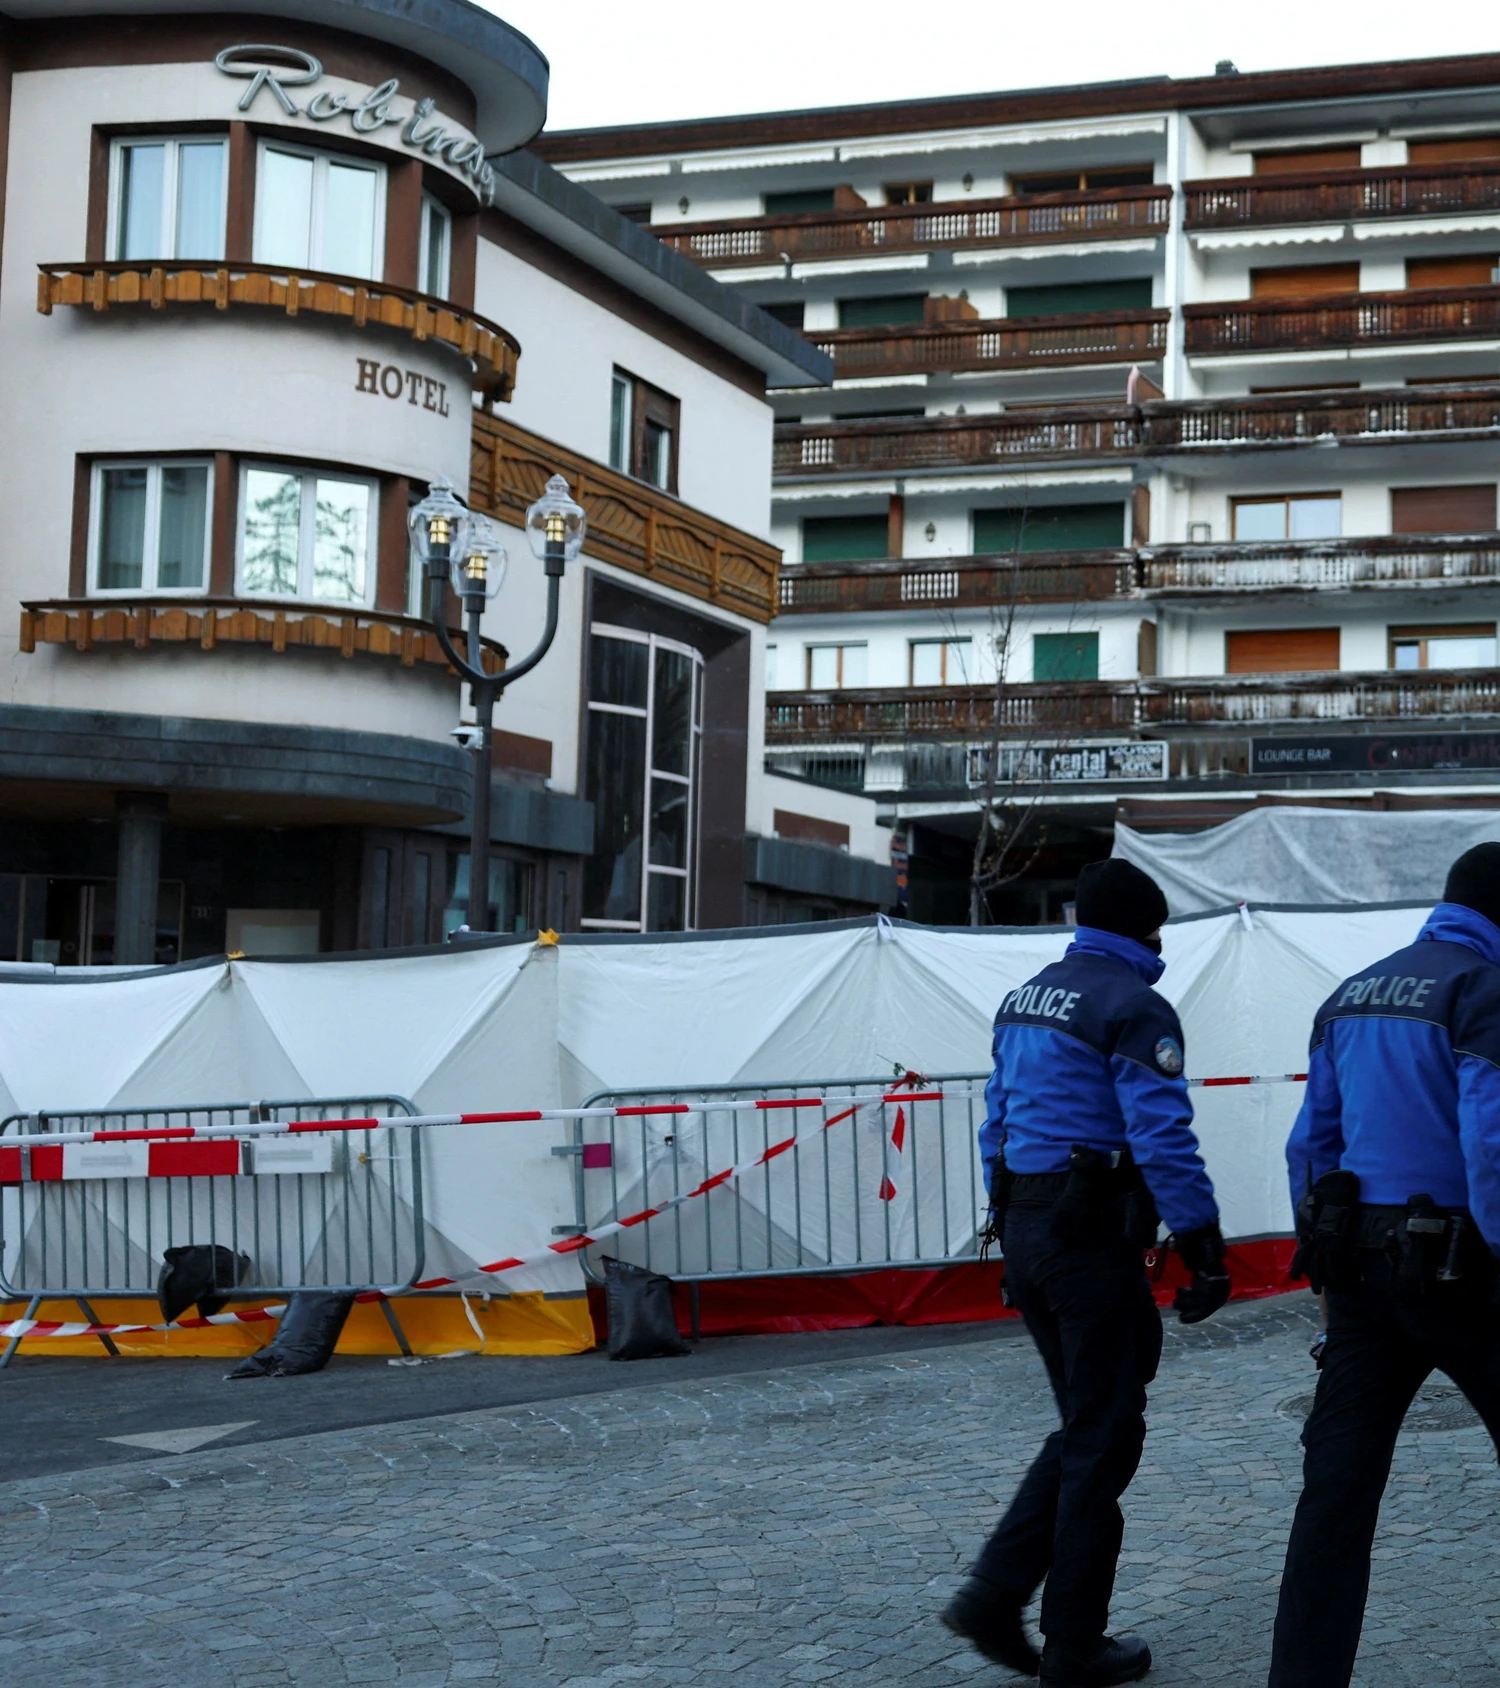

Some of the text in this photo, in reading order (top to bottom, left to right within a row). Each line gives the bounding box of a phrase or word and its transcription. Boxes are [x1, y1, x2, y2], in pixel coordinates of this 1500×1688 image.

[355, 357, 449, 418] HOTEL
[1050, 749, 1106, 771] rental
[1257, 747, 1332, 762] LOUNGE BAR
[1002, 984, 1082, 1022] POLICE
[1336, 975, 1438, 1008] POLICE
